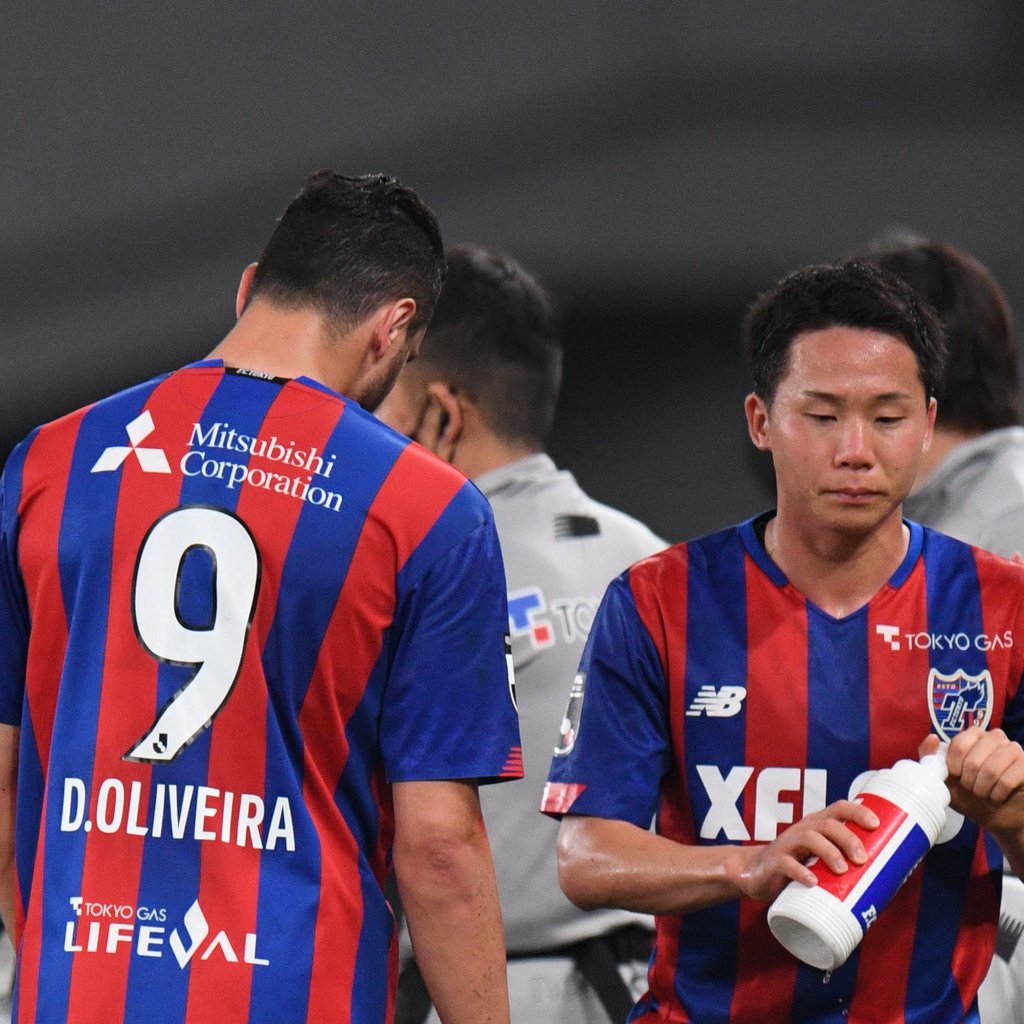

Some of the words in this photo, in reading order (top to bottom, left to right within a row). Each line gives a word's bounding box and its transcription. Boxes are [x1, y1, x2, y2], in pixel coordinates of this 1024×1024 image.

[186, 422, 337, 478] Mitsubishi
[180, 451, 343, 512] Corporation
[124, 505, 262, 761] 9
[904, 632, 970, 651] TOKYO
[974, 630, 1014, 652] GAS
[60, 777, 296, 852] D.OLIVEIRA
[64, 898, 270, 970] LIFEVAL
[85, 902, 134, 919] TOKYO
[136, 906, 167, 922] GAS
